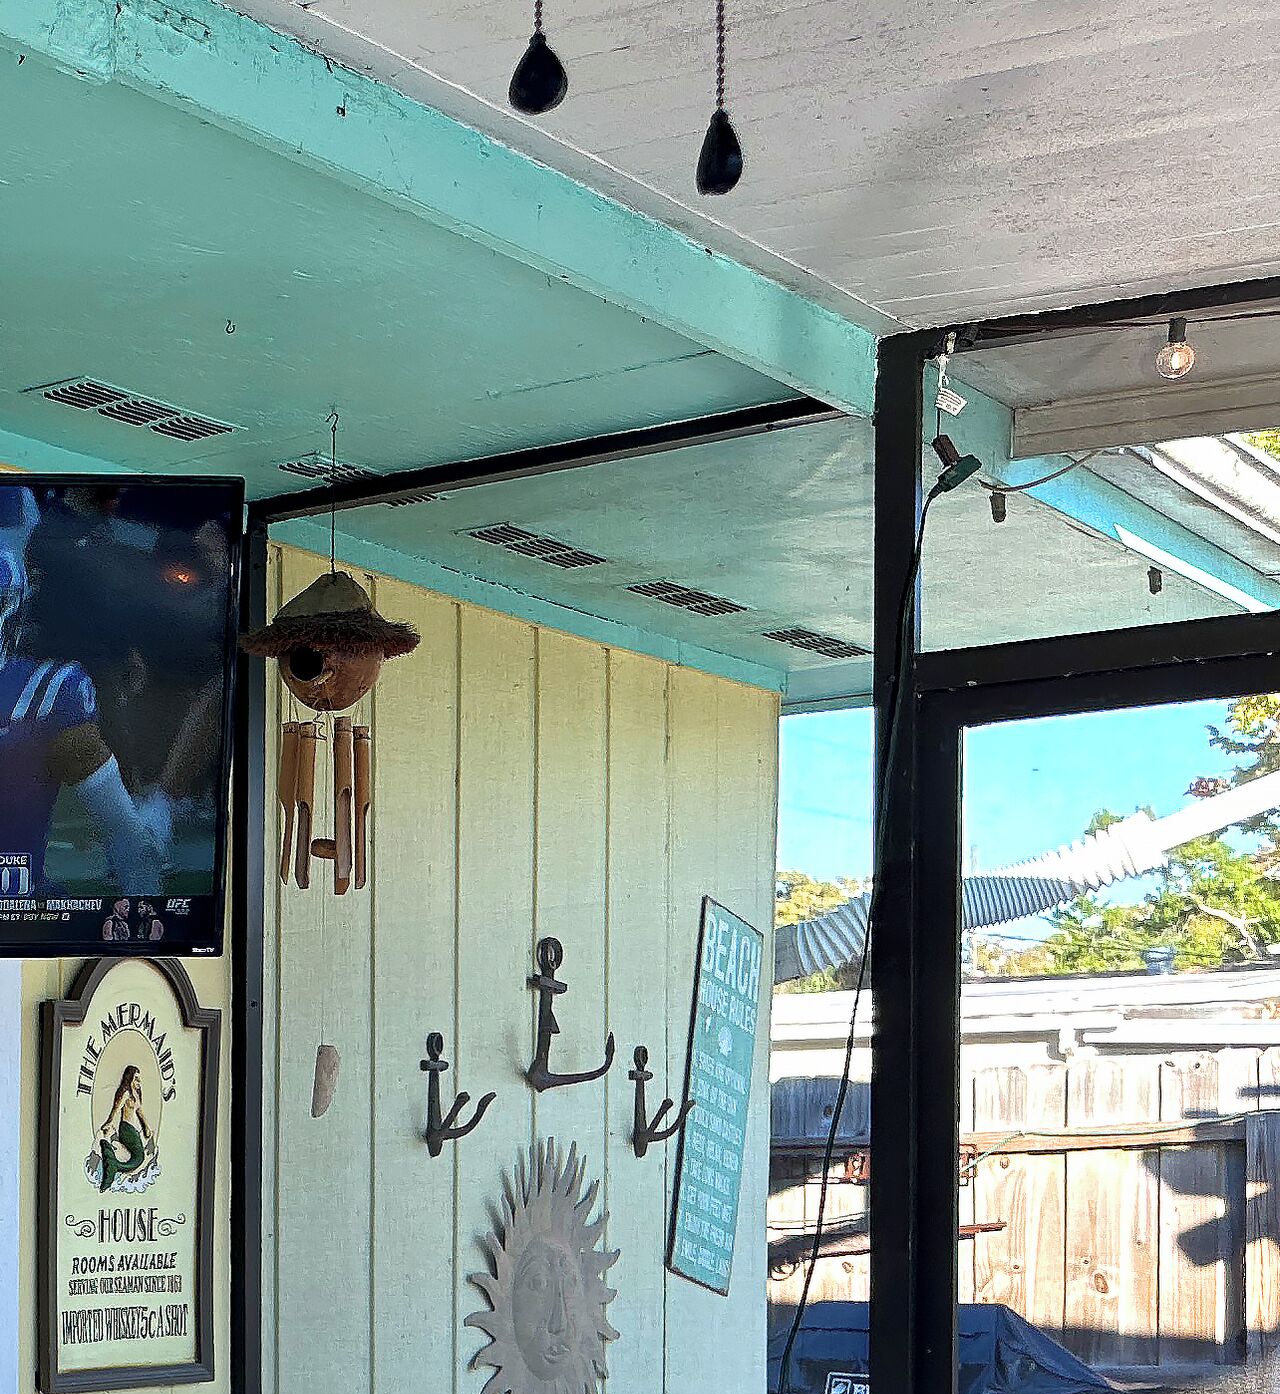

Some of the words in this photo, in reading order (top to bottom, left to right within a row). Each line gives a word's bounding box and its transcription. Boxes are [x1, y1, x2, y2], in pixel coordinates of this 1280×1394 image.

[166, 898, 191, 908] UFC
[702, 911, 762, 1003] BEACH
[699, 976, 729, 1019] HOUSE
[728, 995, 756, 1036] RULES
[76, 1036, 102, 1097] THE
[100, 1003, 177, 1102] MERMAID'S
[98, 1207, 159, 1244] HOUSE
[72, 1254, 115, 1275] ROOMS
[117, 1252, 178, 1272] AVAILABLE
[61, 1308, 103, 1345] IMPORTED
[104, 1306, 140, 1341] WHISKEY
[157, 1304, 165, 1338] A
[165, 1304, 189, 1337] SHOT
